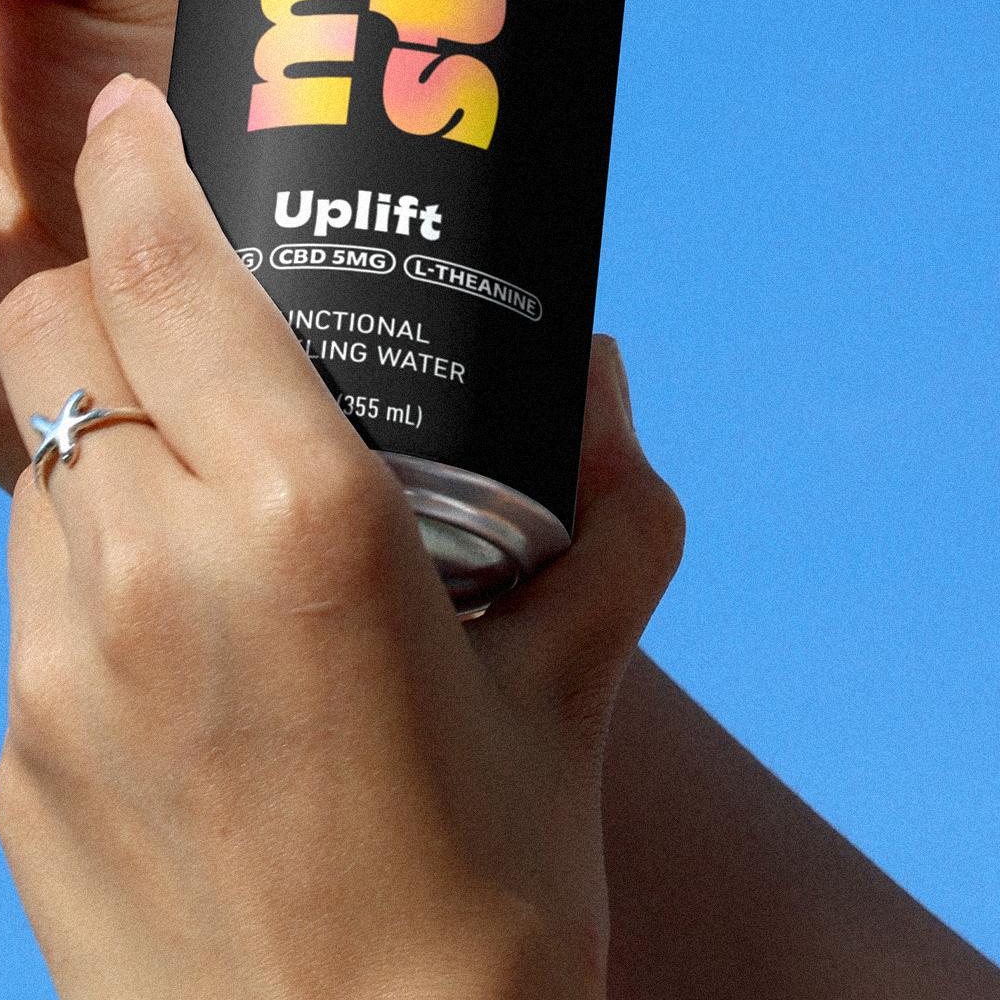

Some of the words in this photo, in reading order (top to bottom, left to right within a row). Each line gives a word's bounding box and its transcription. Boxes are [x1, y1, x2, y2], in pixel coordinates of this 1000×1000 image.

[274, 190, 443, 241] Uplift
[278, 249, 327, 265] CBD
[331, 249, 387, 270] 5MG
[415, 259, 537, 317] L-THEANINE
[299, 339, 367, 363] LING
[377, 345, 466, 384] WATER
[386, 404, 423, 429] mL)
